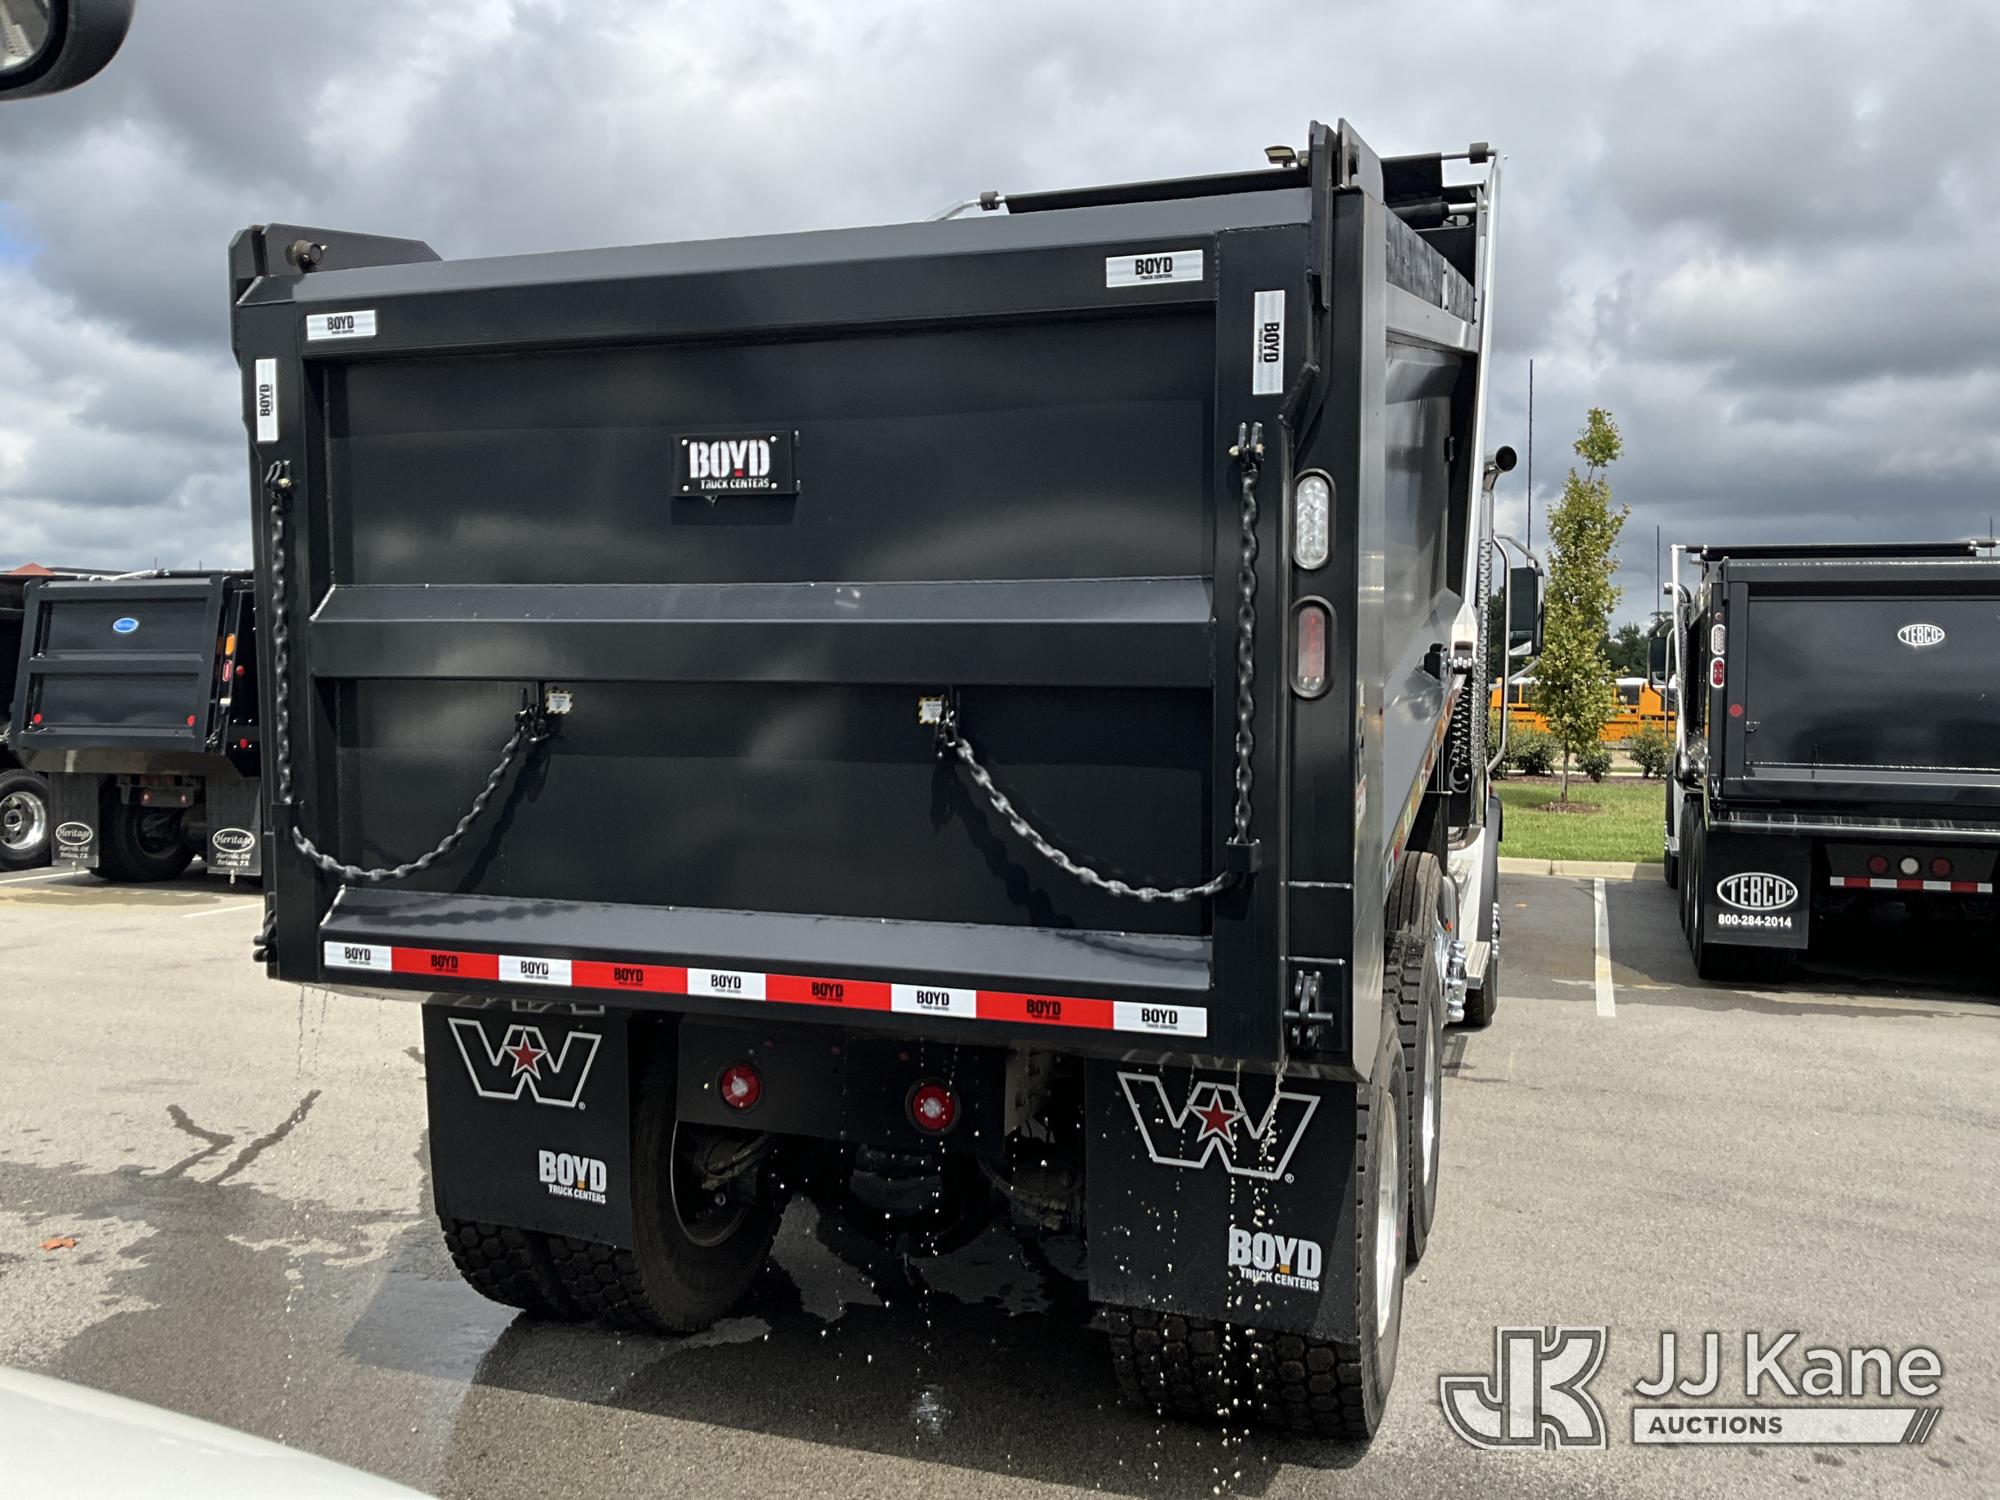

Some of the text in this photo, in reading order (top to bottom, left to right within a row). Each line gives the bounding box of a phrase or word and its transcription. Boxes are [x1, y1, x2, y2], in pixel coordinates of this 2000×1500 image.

[1135, 256, 1173, 275] BOYD
[327, 315, 354, 330] BOYD
[1263, 322, 1280, 363] BOYD
[260, 384, 270, 416] BOYD
[689, 439, 770, 478] BOYD
[701, 478, 769, 489] TRUCK CENTERS
[1904, 626, 1938, 643] TEBCO
[58, 828, 91, 840] Heritage
[215, 833, 253, 847] Heritage
[1726, 876, 1786, 907] TEBCO
[1718, 914, 1792, 928] 800-284-2014
[344, 947, 371, 961] BOYD
[431, 955, 458, 969] BOYD
[520, 960, 549, 975] BOYD
[614, 967, 643, 982] BOYD
[711, 974, 741, 989] BOYD
[812, 982, 843, 998] BOYD
[916, 990, 950, 1006] BOYD
[1026, 999, 1062, 1016] BOYD
[1141, 1007, 1178, 1024] BOYD
[539, 1150, 607, 1193] BOYD
[548, 1183, 606, 1204] TRUCK CENTERS
[1228, 1226, 1322, 1279] BOYD
[1239, 1266, 1320, 1292] TRUCK CENTERS
